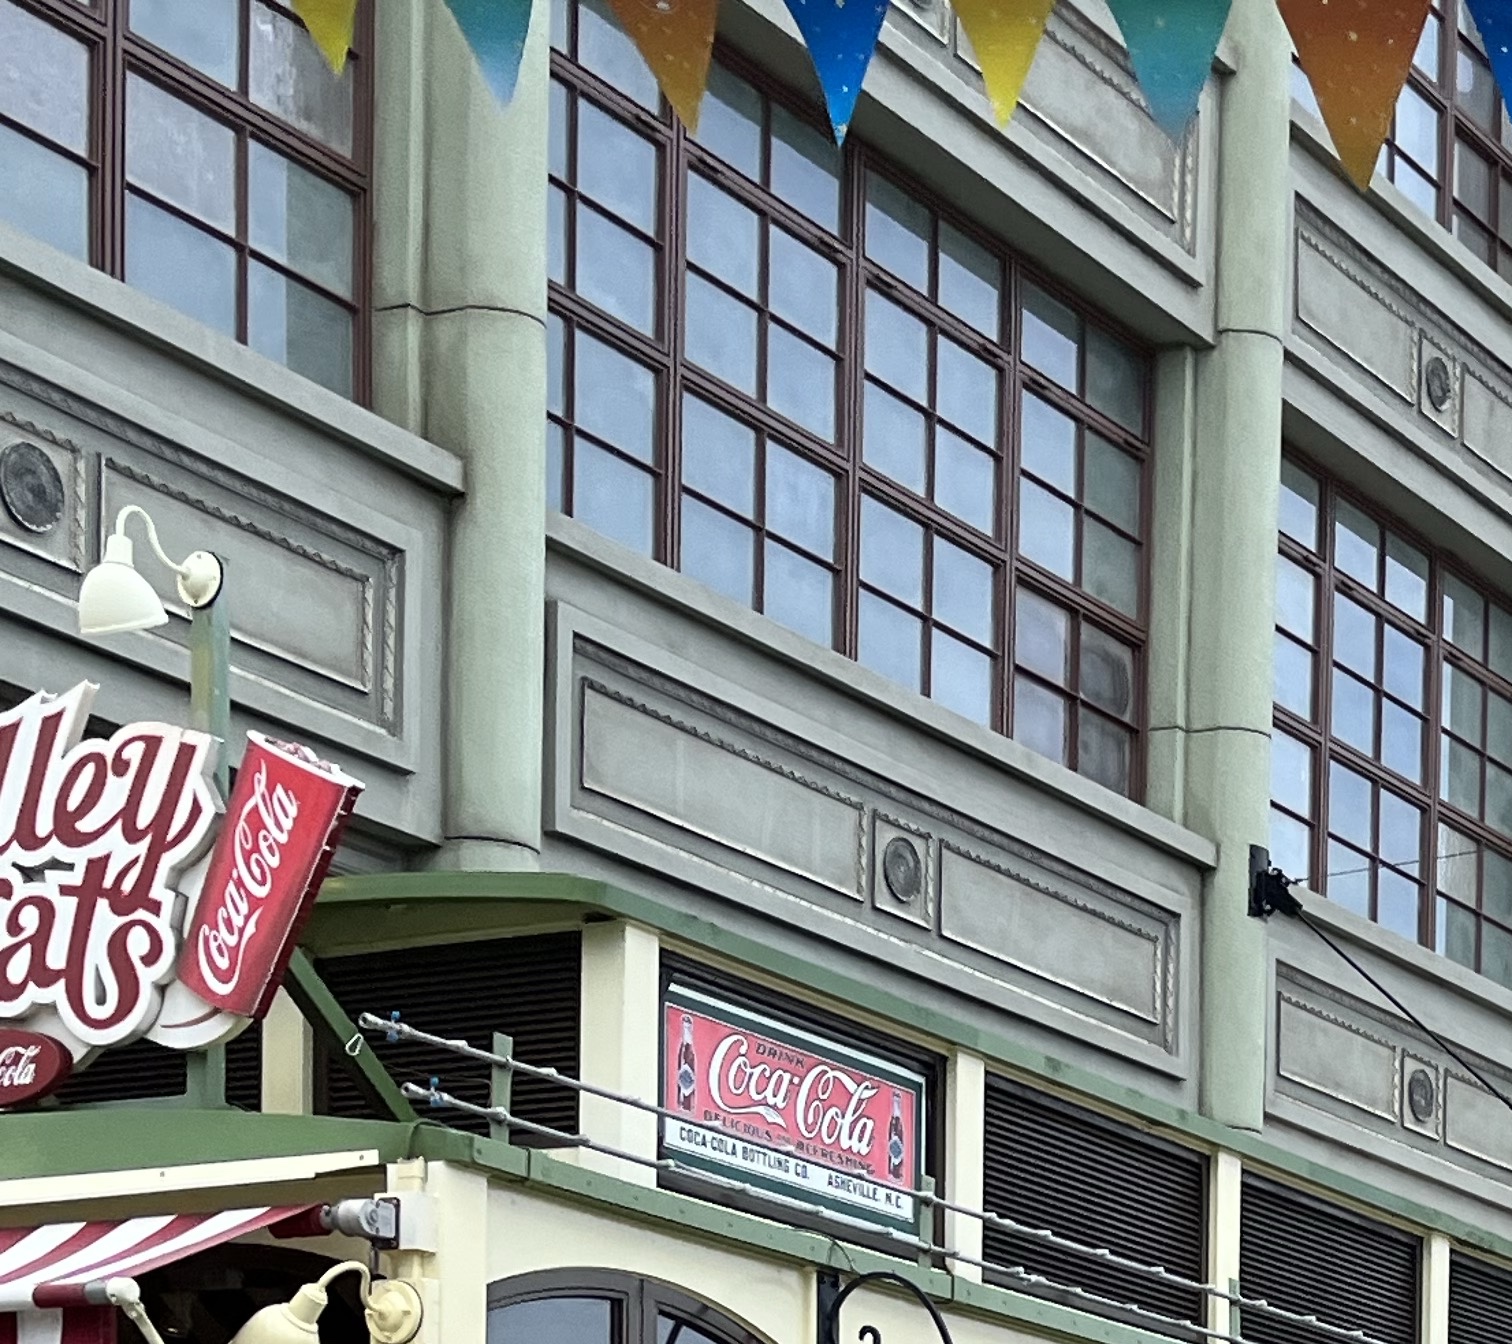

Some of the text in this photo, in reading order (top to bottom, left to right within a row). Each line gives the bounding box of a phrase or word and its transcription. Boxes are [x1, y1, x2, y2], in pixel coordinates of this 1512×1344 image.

[0, 850, 164, 1030] ats
[198, 759, 299, 996] Coca-Cola
[708, 1033, 880, 1156] Coca-Cola
[742, 1144, 790, 1174] BOTTLING
